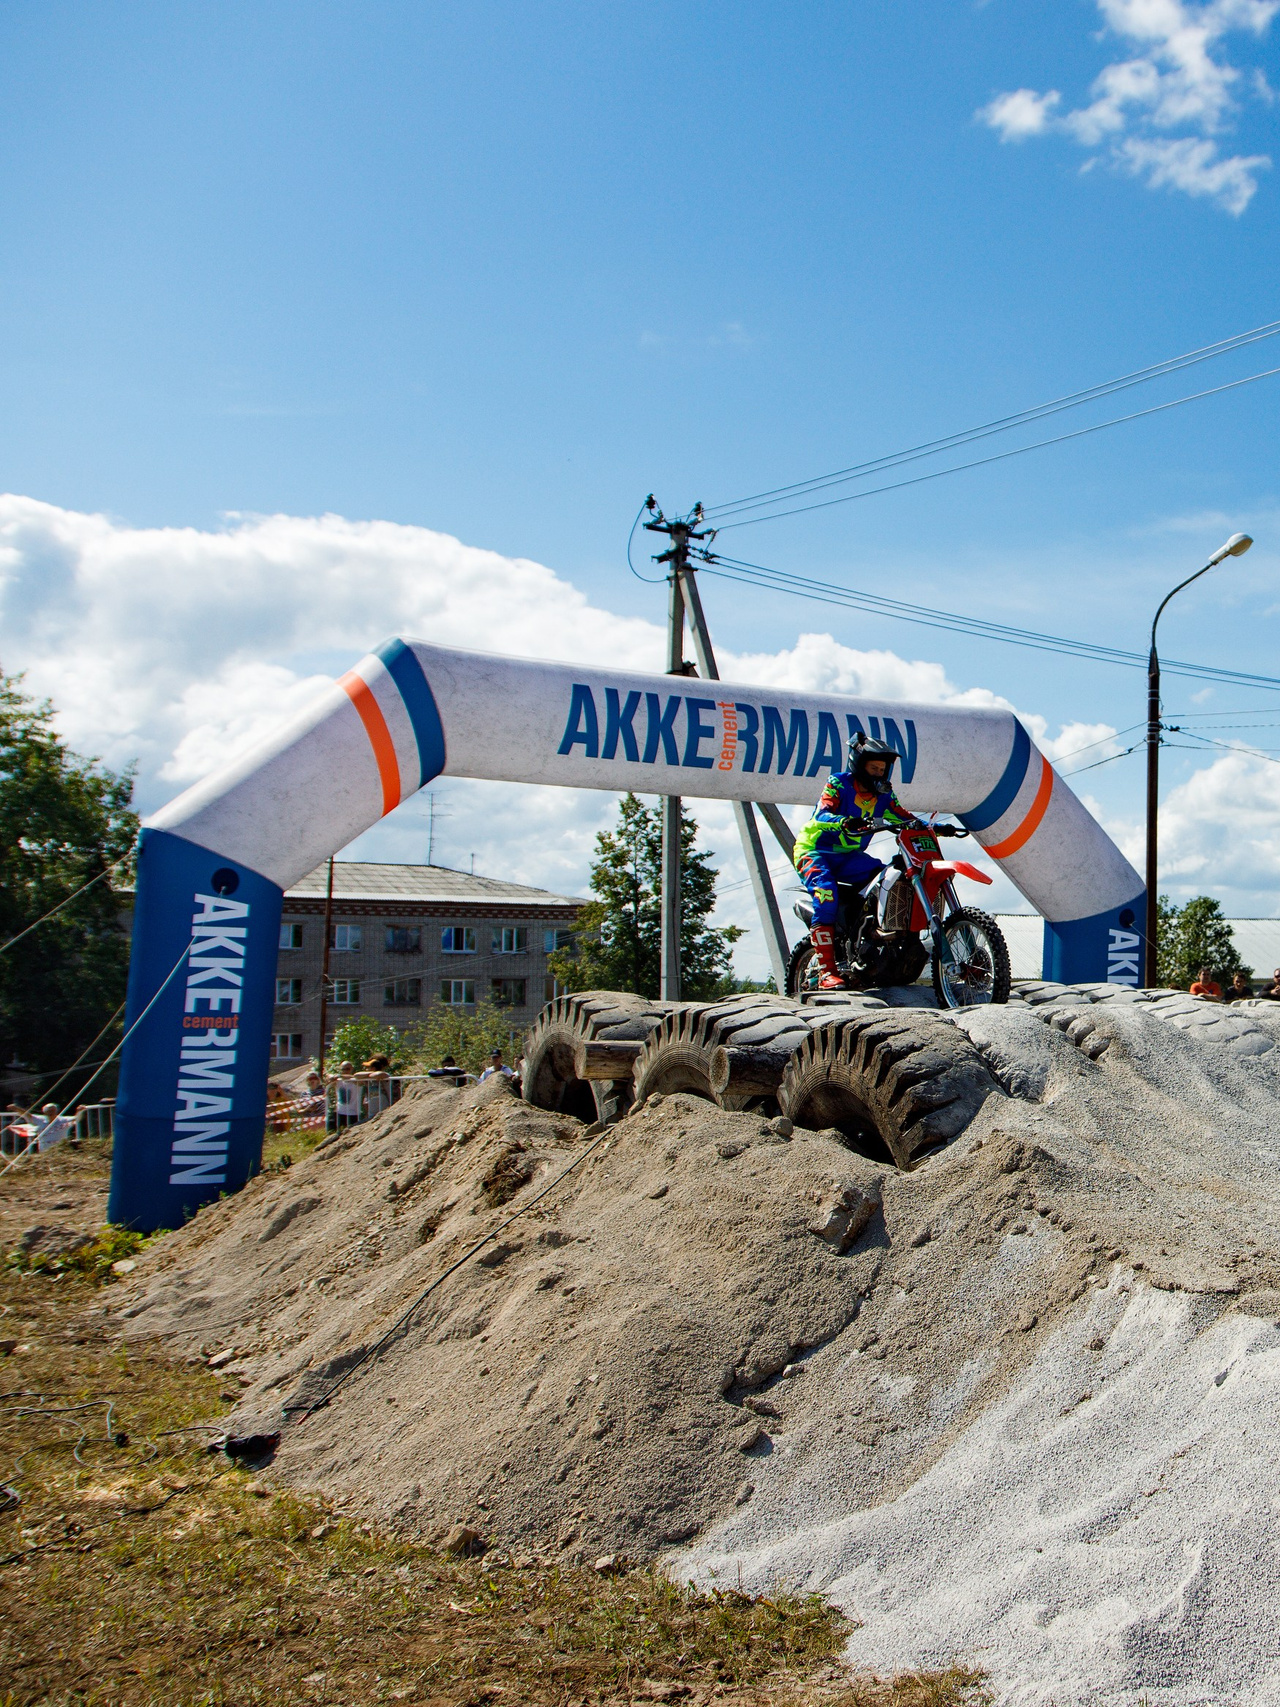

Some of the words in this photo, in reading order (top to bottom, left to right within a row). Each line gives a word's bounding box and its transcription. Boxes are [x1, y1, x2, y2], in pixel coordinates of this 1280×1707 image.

[717, 701, 738, 771] cement
[169, 893, 250, 1185] AKKERMANN
[182, 1014, 239, 1029] cement
